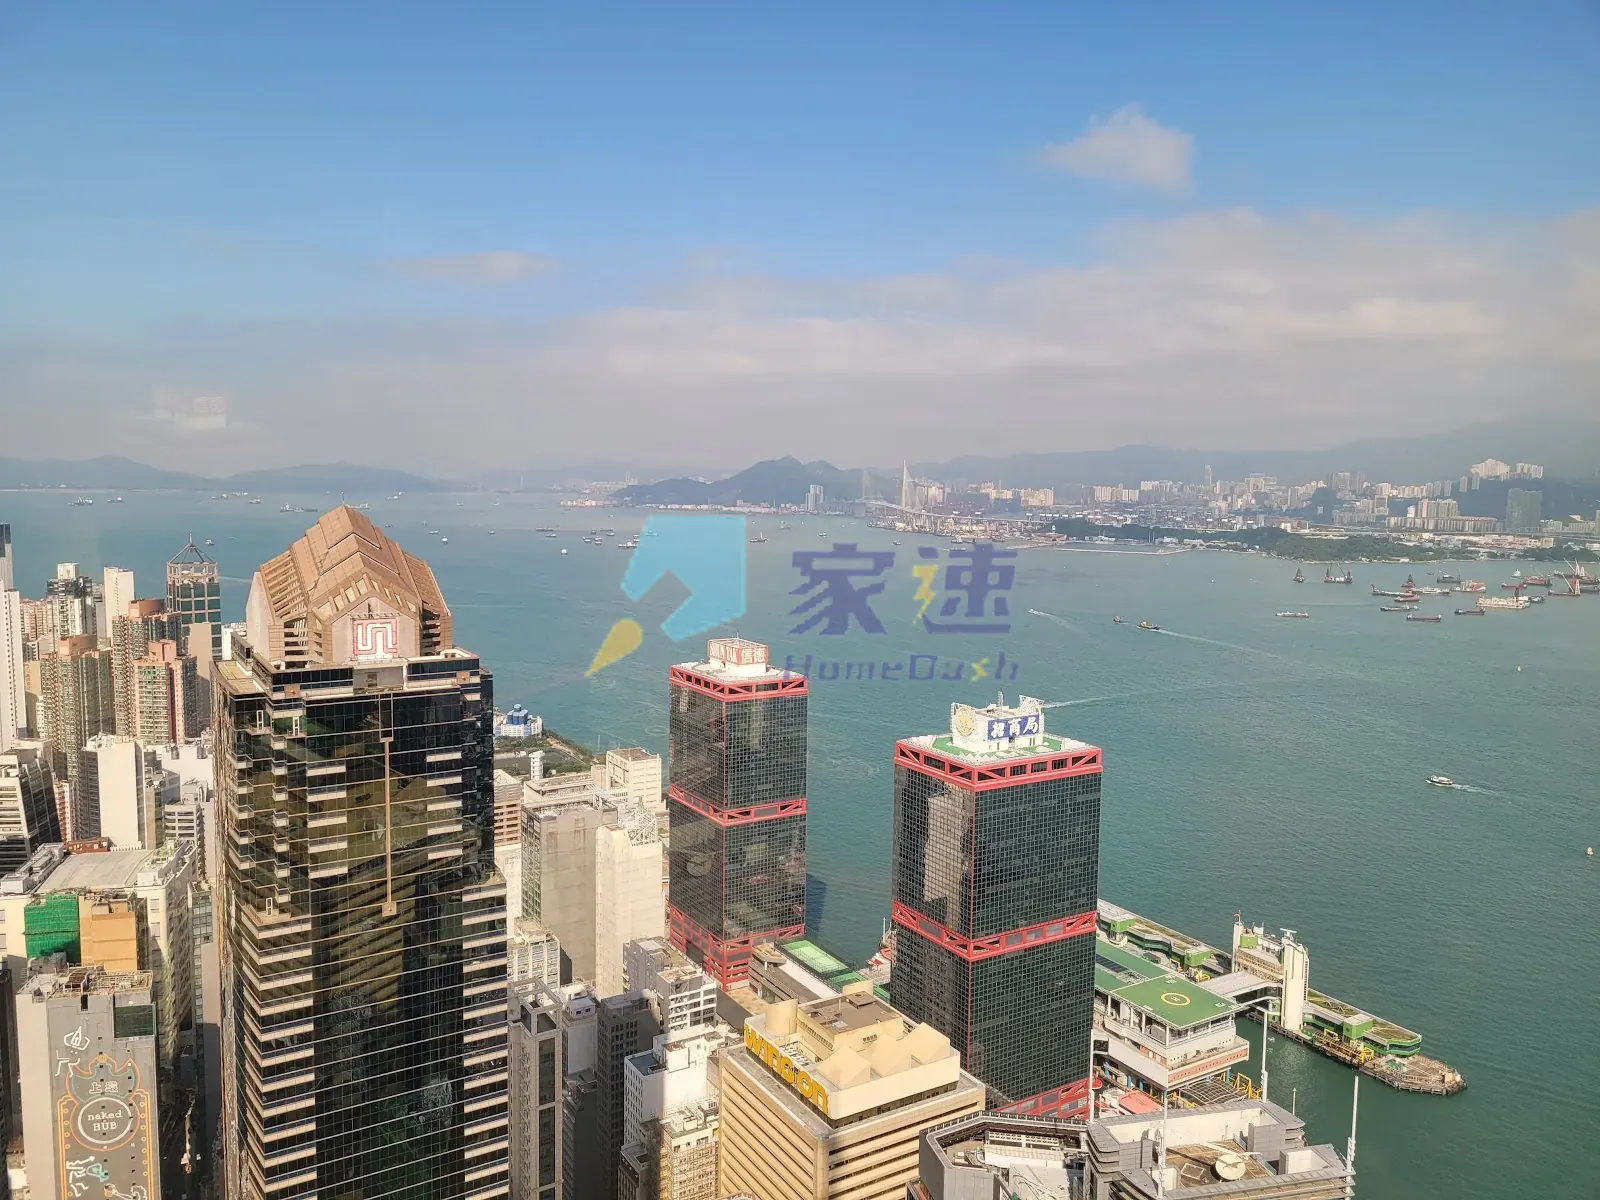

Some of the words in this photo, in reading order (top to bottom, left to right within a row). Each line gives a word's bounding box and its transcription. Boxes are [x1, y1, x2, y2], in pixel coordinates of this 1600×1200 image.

[741, 648, 765, 664] 信德
[991, 716, 1038, 738] 招商局
[88, 1110, 123, 1121] naked
[93, 1122, 117, 1131] HUB
